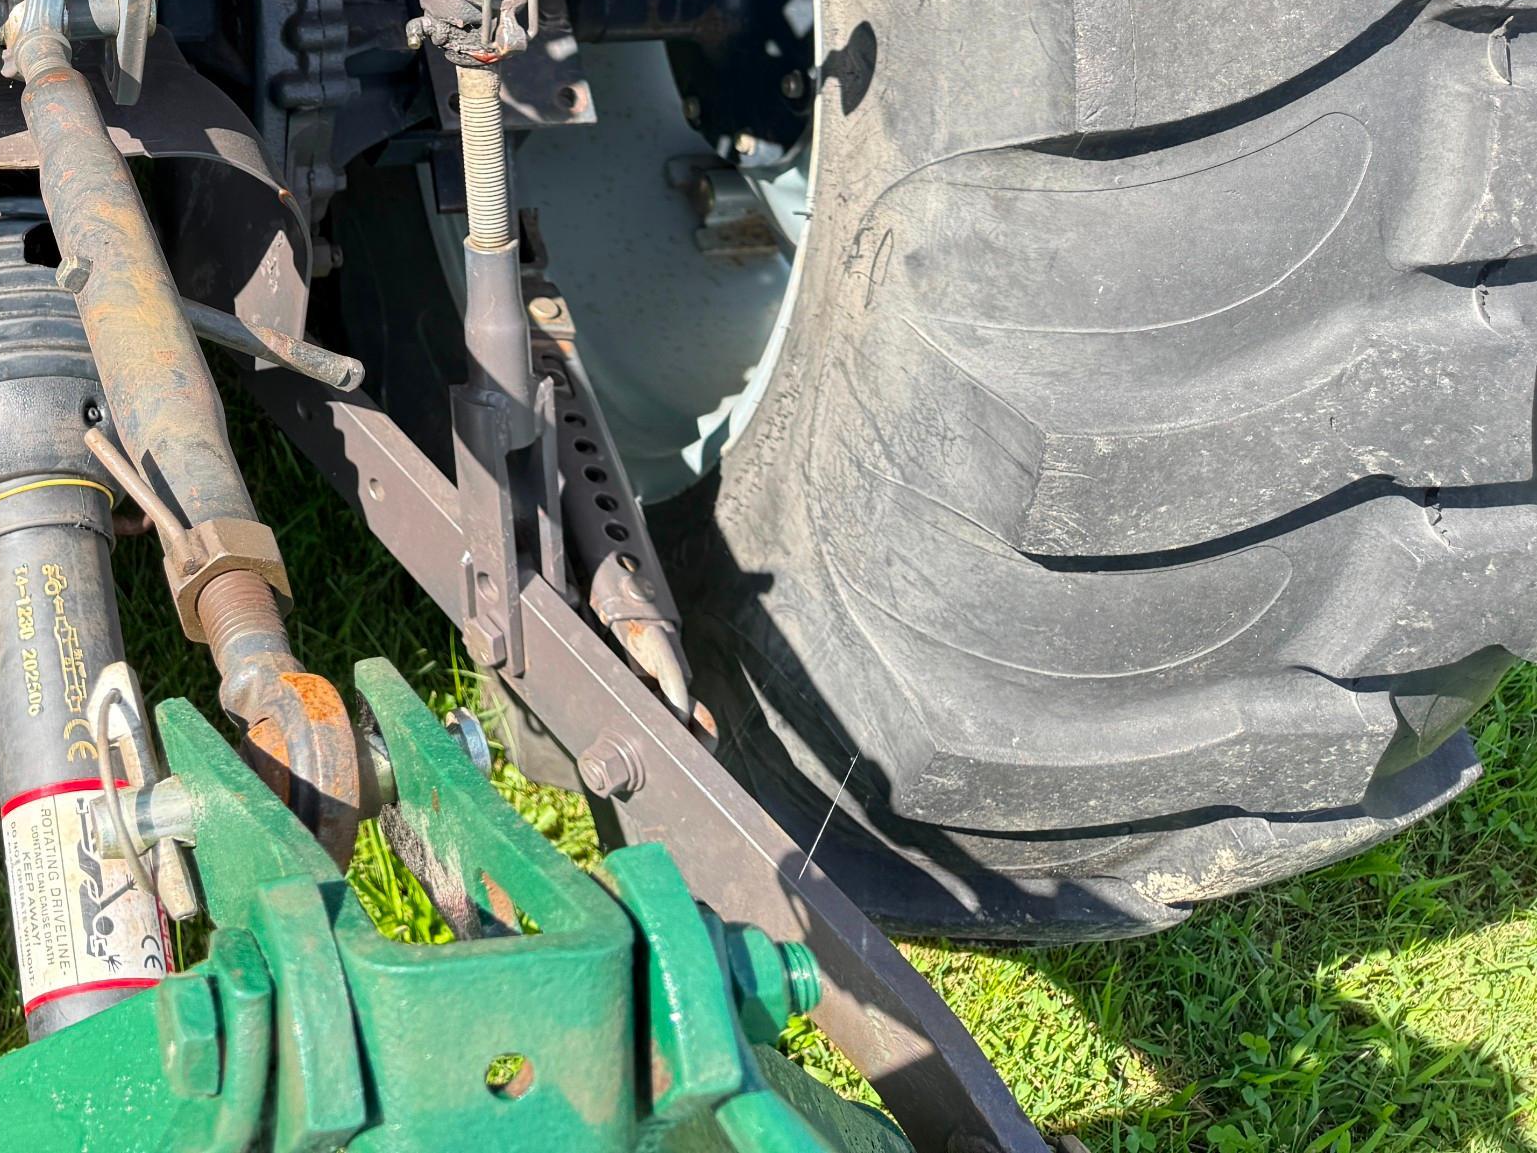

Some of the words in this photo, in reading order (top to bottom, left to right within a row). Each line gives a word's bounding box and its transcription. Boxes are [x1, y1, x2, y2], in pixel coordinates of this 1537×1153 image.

[31, 824, 44, 870] CONTACT
[41, 808, 60, 881] ROTATING
[22, 851, 35, 892] KEEP
[37, 872, 46, 894] CAN
[28, 896, 41, 946] AWAY!
[40, 896, 51, 929] CAUSE
[44, 931, 55, 966] DEATH
